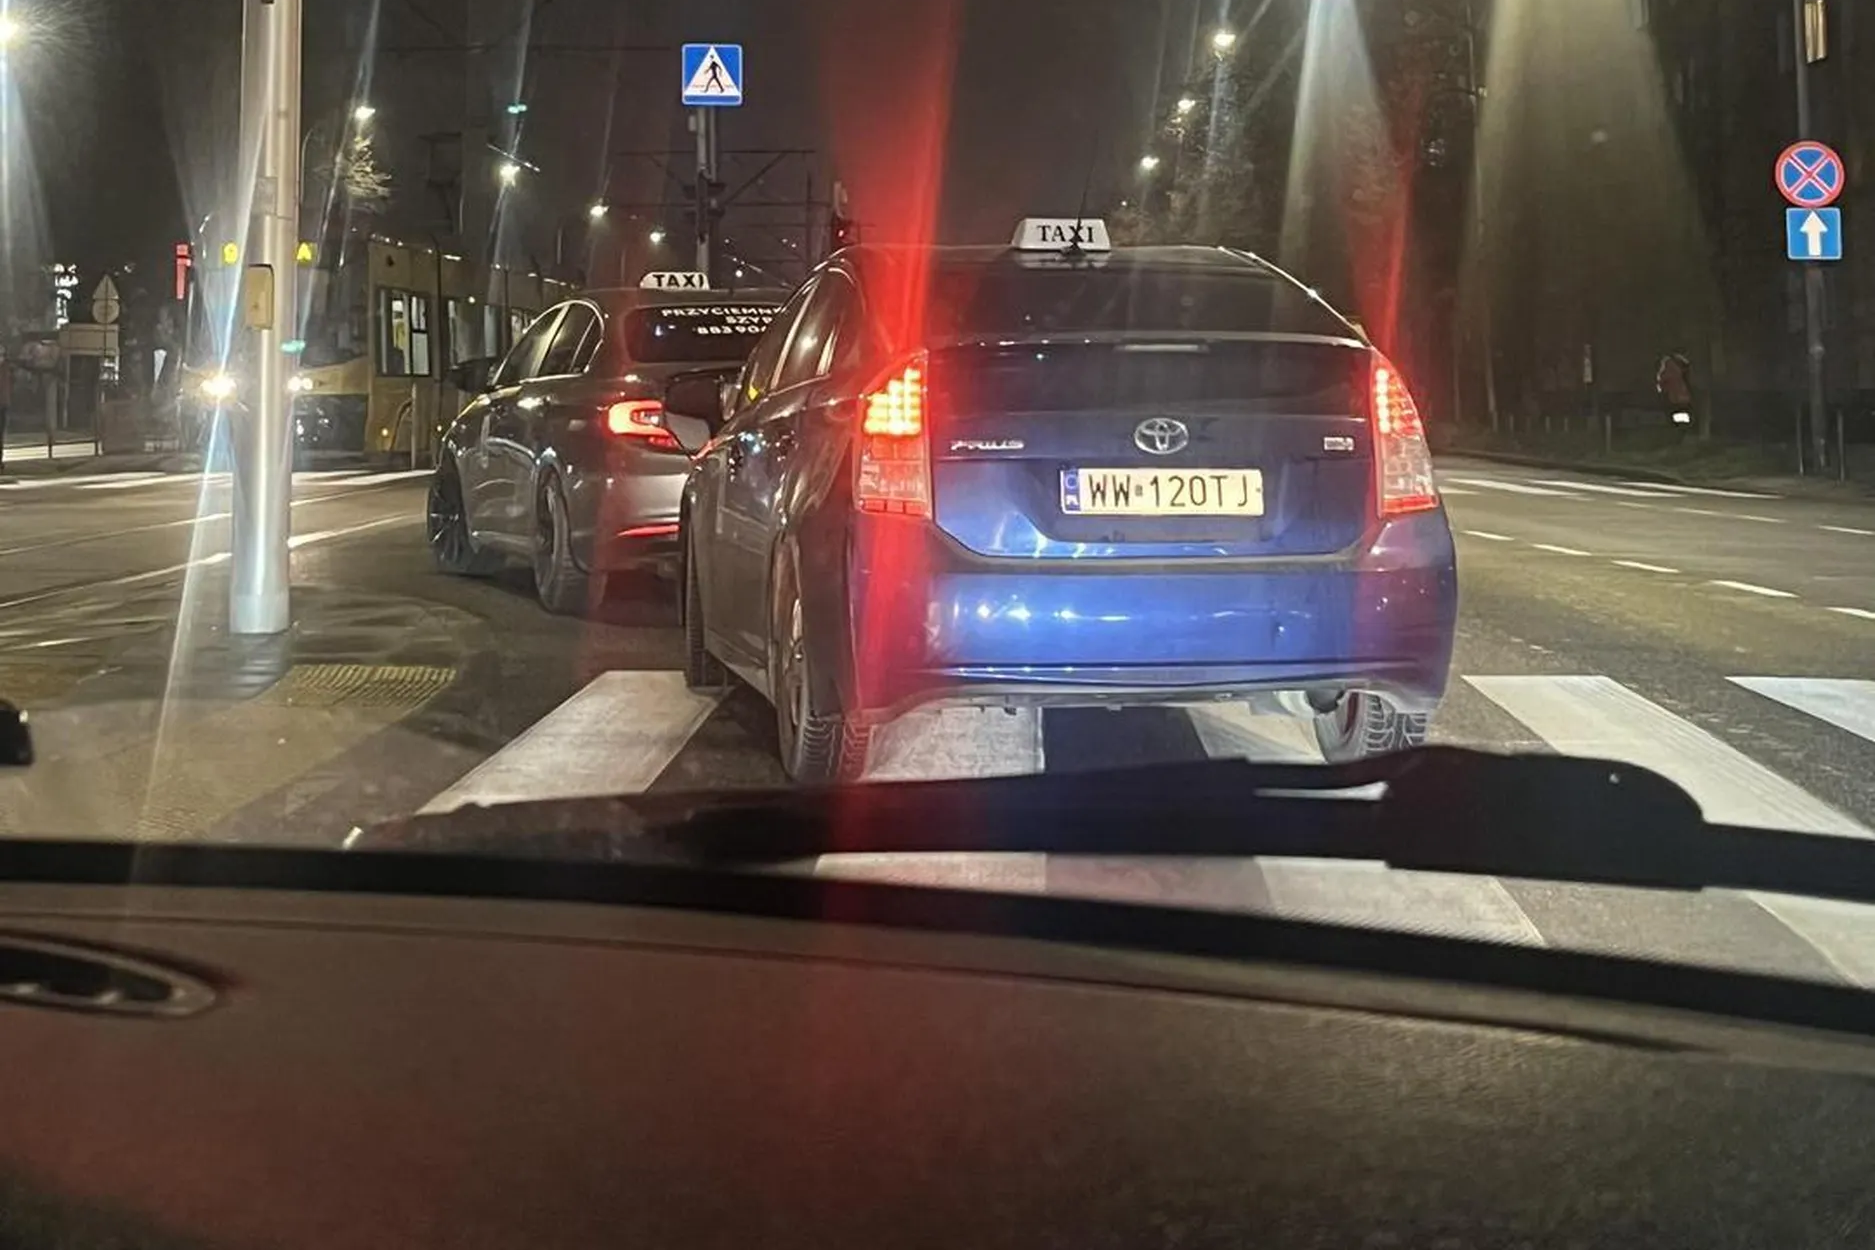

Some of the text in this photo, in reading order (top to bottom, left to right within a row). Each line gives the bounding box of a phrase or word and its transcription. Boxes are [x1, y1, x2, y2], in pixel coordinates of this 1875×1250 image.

[1036, 224, 1094, 243] TAXI
[652, 274, 704, 288] TAXI
[1088, 475, 1248, 507] WW 120TJ
